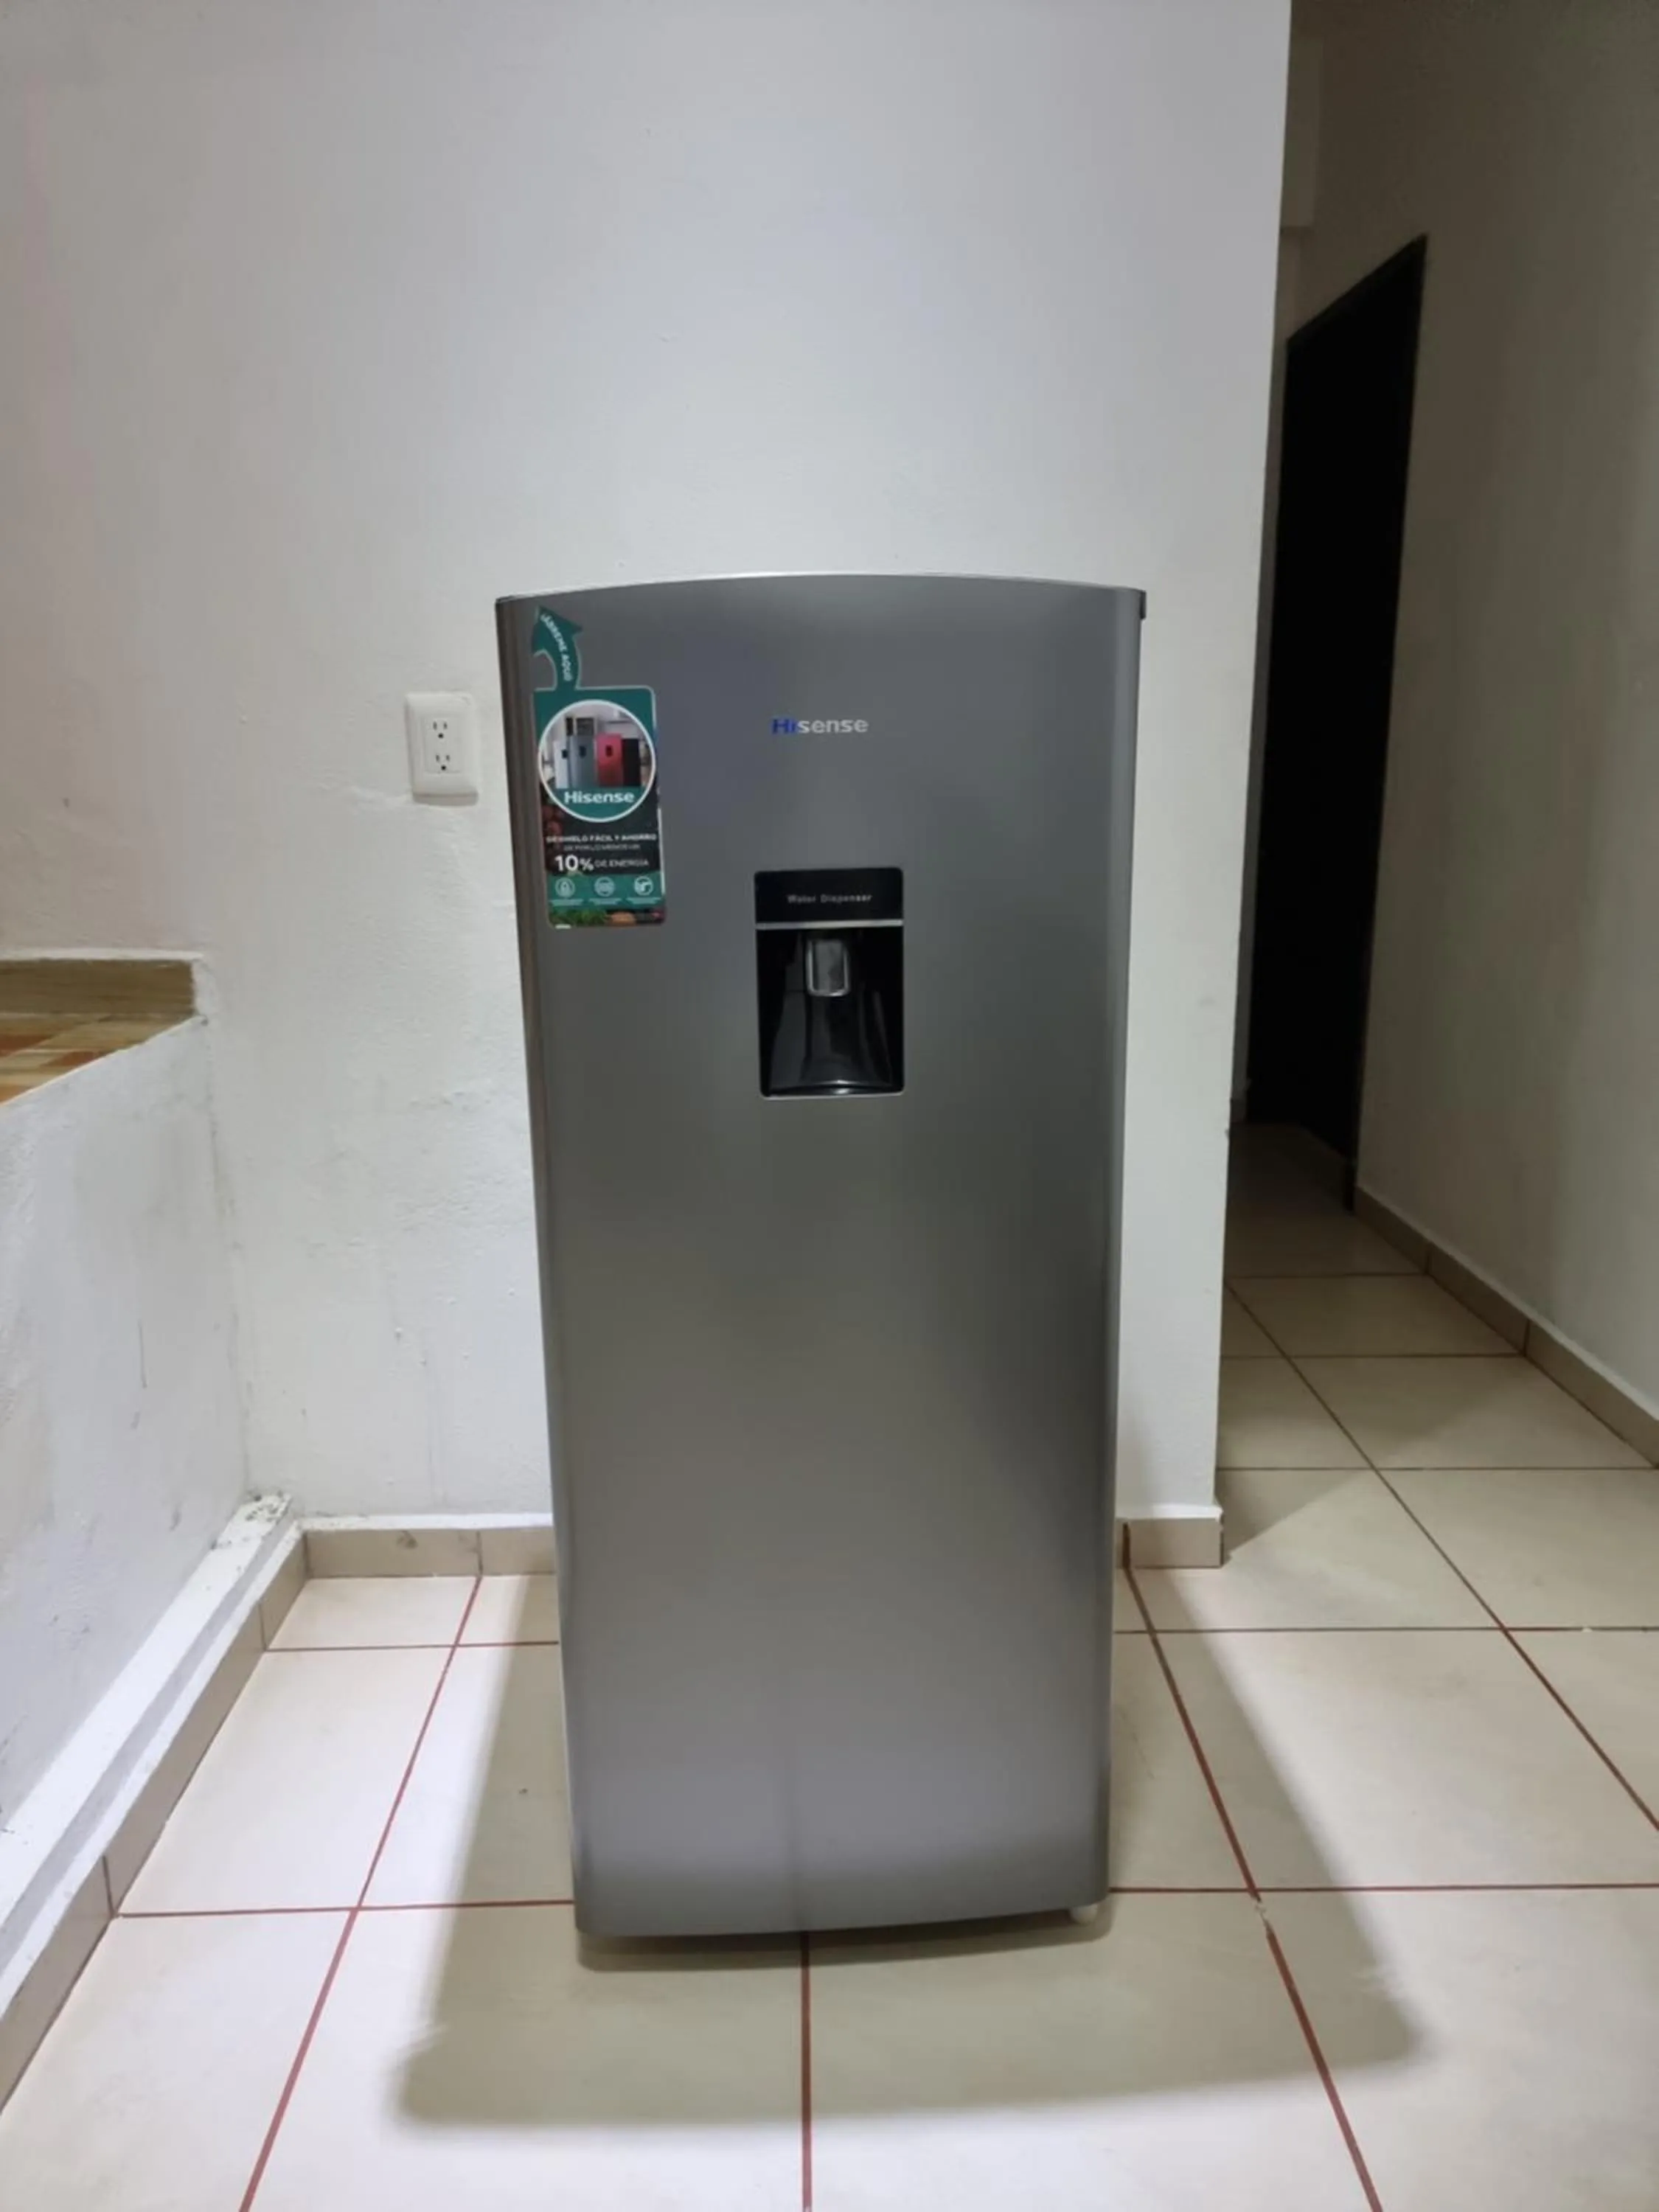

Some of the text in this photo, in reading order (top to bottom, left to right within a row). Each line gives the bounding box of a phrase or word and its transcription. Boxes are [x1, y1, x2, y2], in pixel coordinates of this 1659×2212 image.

[772, 718, 869, 734] Hisense
[563, 790, 635, 804] Hisense
[554, 854, 594, 872] 10%
[787, 893, 873, 904] Water Dispenser
